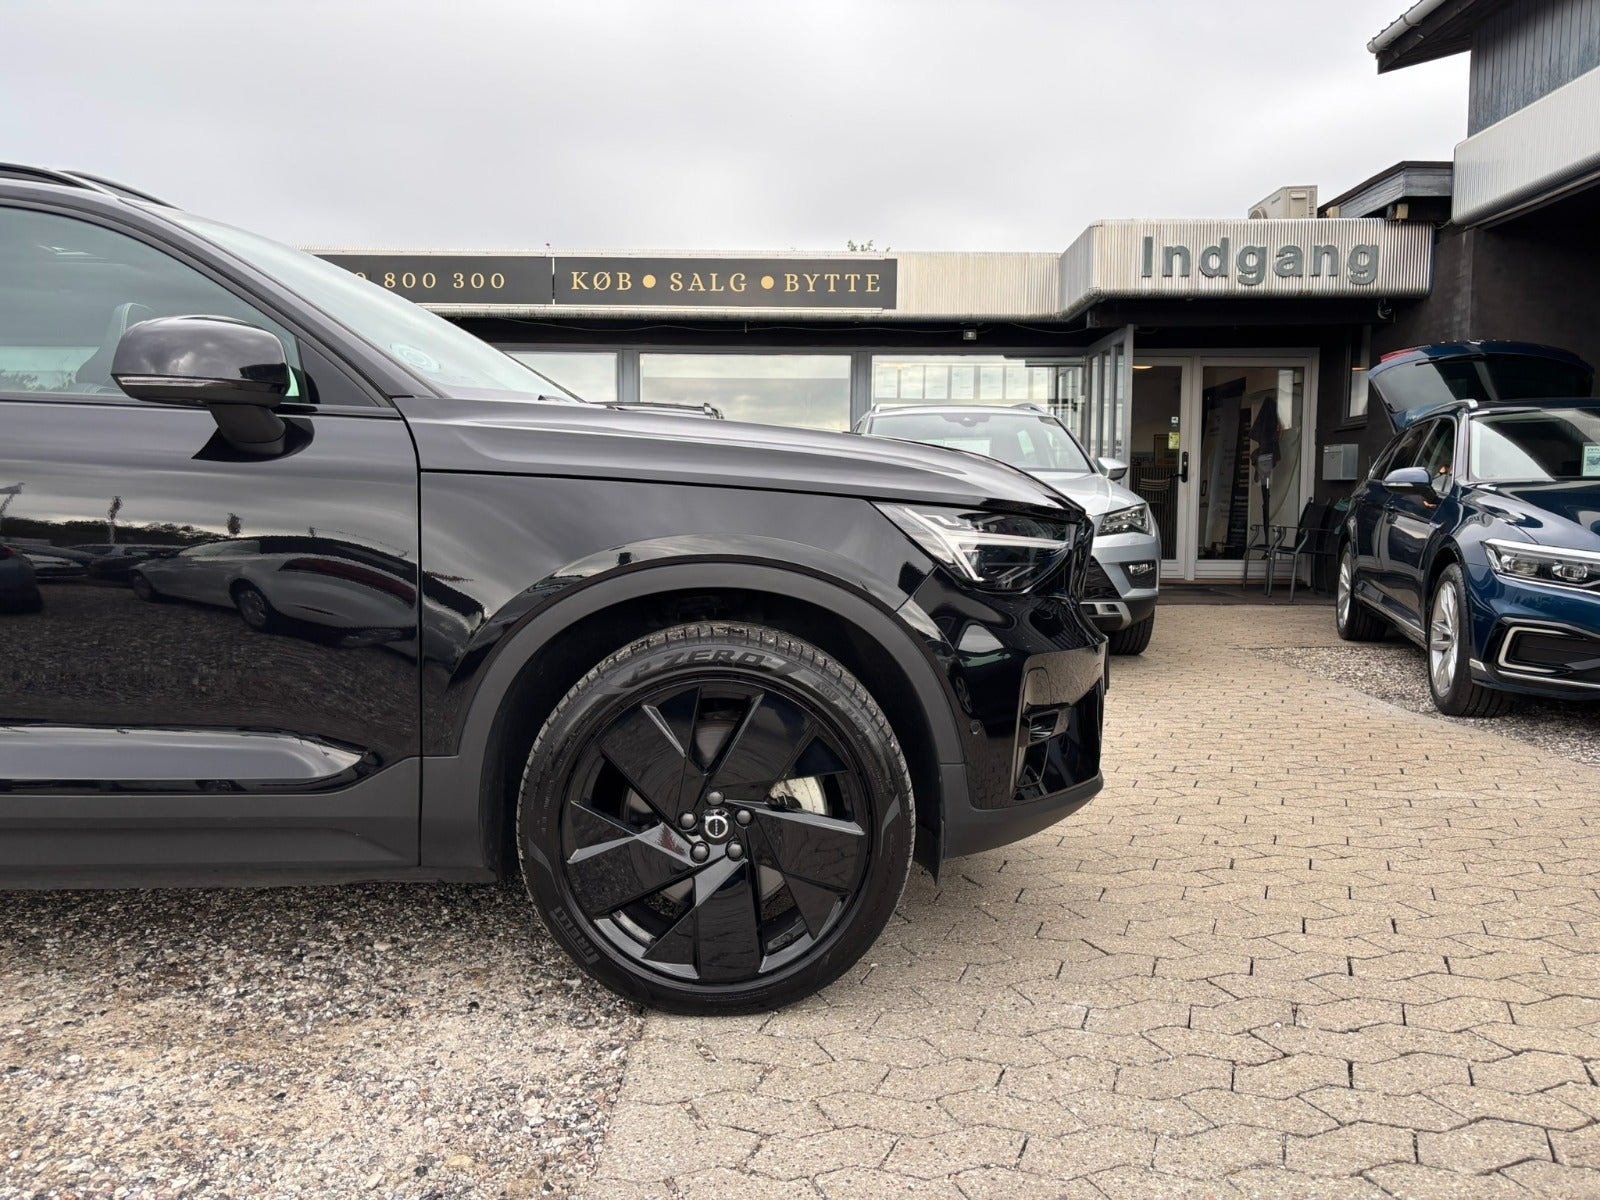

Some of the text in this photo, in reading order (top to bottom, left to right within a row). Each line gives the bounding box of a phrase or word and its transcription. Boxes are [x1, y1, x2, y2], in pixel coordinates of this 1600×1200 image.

[1141, 236, 1380, 286] Indgang
[383, 272, 437, 290] 800
[452, 272, 506, 290] 300
[571, 271, 882, 294] KØB SALG BYTTE
[661, 649, 767, 668] ZERO
